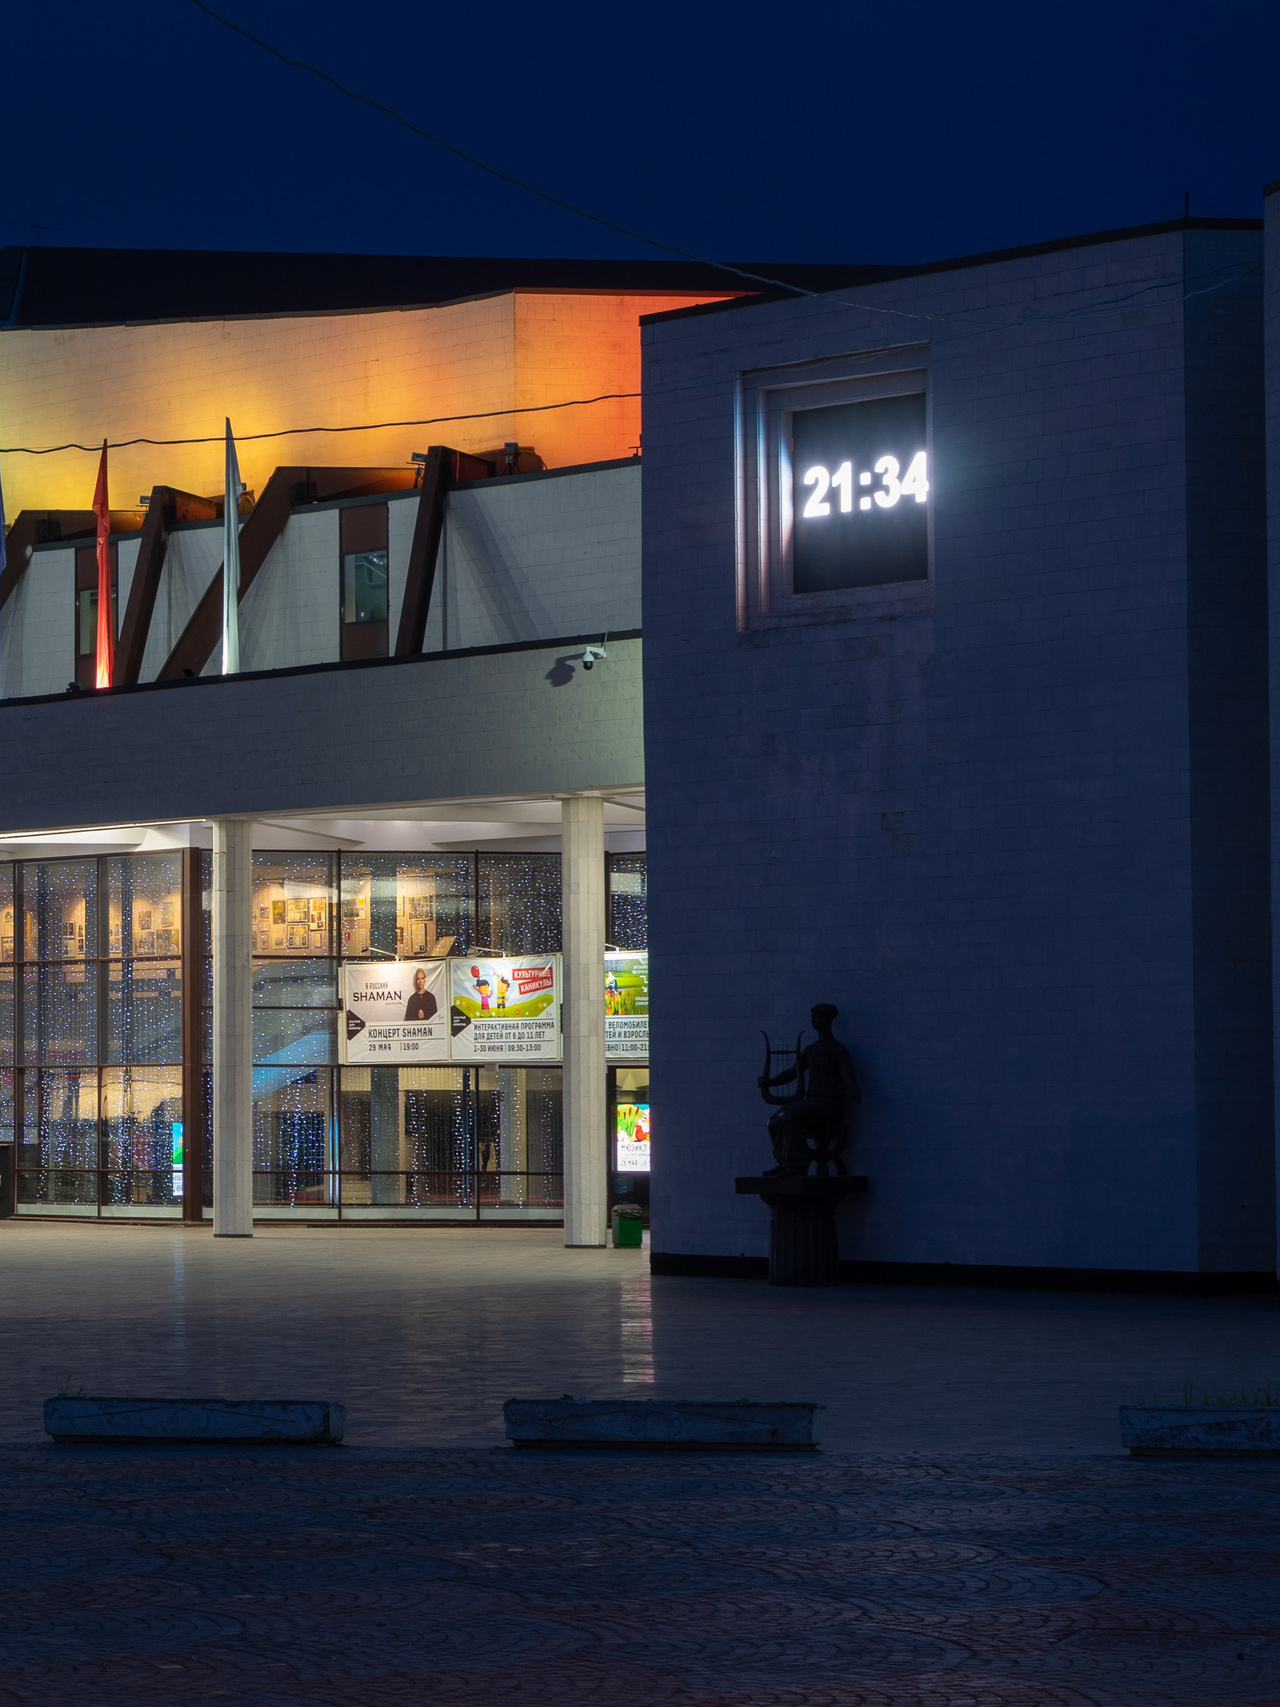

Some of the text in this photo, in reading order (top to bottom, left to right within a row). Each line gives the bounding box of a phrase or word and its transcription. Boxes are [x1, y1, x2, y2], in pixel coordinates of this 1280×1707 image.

[803, 451, 929, 518] 21:34
[520, 978, 552, 992] КАНИКУЛЫ
[353, 991, 402, 1002] SHAMAN
[474, 1022, 555, 1031] ИНТЕРАКТИВНАЯ ПРОГРАММА
[368, 1027, 433, 1039] КОНЦЕРТ SHAMAN
[474, 1032, 485, 1041] ДЛЯ
[486, 1031, 503, 1041] ДЕТЕЙ
[518, 1032, 525, 1040] ДО
[535, 1031, 545, 1039] ЛЕТ
[378, 1043, 391, 1051] МАЯ
[403, 1042, 419, 1051] 19:00
